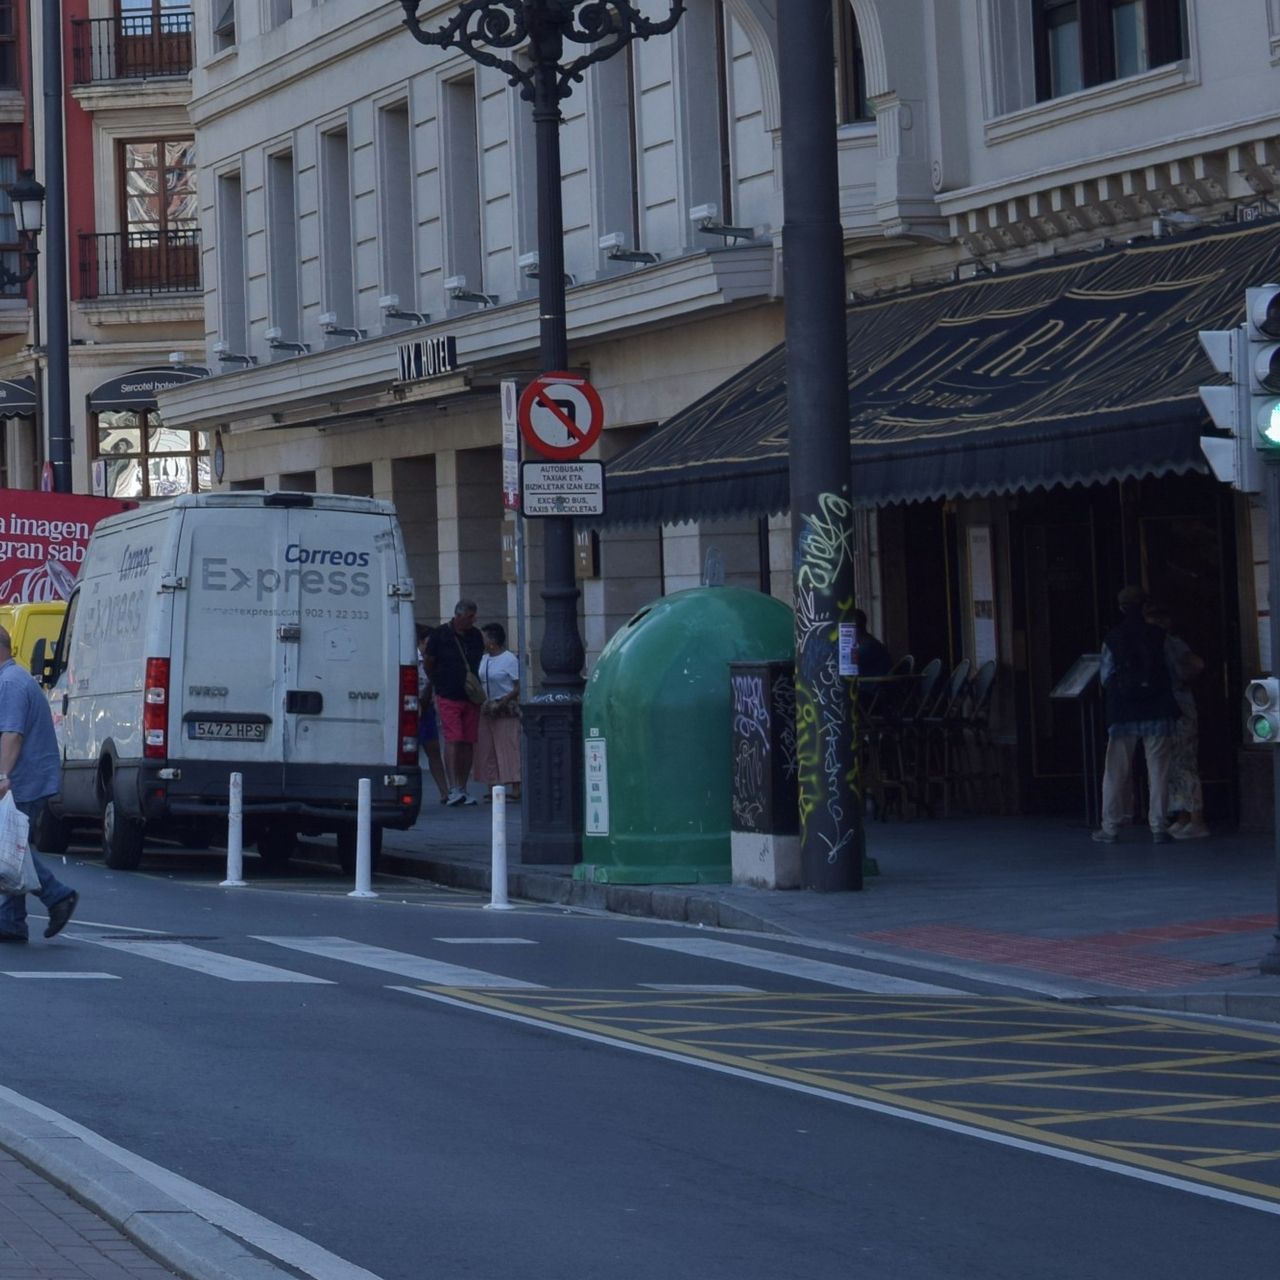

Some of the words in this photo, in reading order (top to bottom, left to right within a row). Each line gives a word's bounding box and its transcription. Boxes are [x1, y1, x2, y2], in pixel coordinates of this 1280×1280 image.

[420, 335, 451, 377] HOTEL
[121, 381, 153, 393] Sercotel
[543, 474, 567, 482] TAXIAK
[525, 483, 566, 491] BIZIKLETAK
[48, 540, 87, 563] sab
[285, 544, 371, 567] Correos
[202, 558, 371, 602] Express
[305, 608, 323, 619] 902
[336, 608, 348, 619] 22
[351, 610, 369, 620] 333
[197, 723, 233, 736] 5472
[236, 723, 265, 737] HPS
